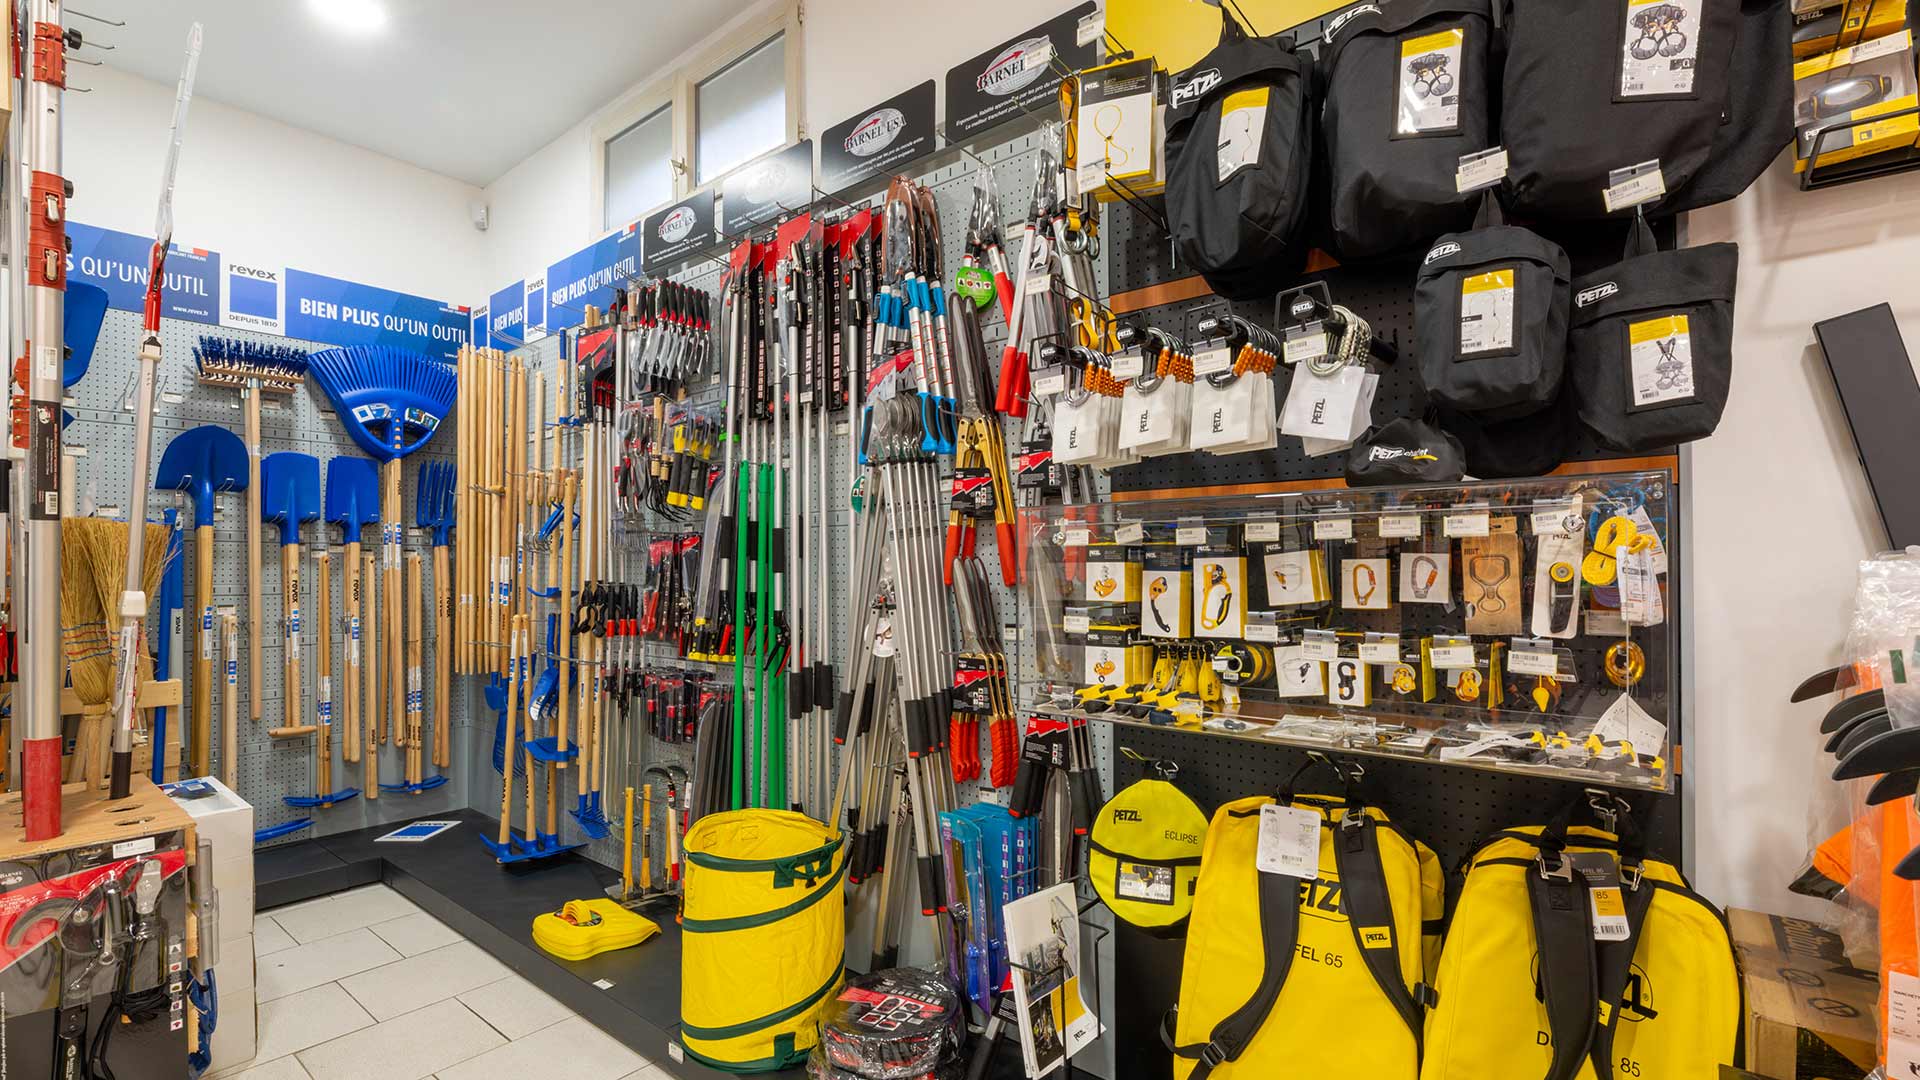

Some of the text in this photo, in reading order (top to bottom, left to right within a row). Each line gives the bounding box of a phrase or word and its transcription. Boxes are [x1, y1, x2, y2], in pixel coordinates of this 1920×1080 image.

[1324, 4, 1382, 44] PETZL
[1797, 10, 1824, 24] PETZL
[1172, 71, 1223, 109] PETZL
[844, 115, 907, 152] BARNEL USA
[1424, 243, 1461, 265] PETZL
[81, 256, 148, 283] QU'UN
[229, 263, 277, 280] revex
[528, 279, 545, 292] revex
[569, 277, 587, 301] PLUS
[1577, 283, 1619, 308] PETZL
[172, 305, 209, 316] www.revex.fr
[300, 298, 338, 321] BIEN
[342, 306, 380, 328] PLUS
[384, 315, 428, 337] QU'UN
[508, 306, 523, 327] PLUS
[1292, 301, 1314, 315] PETZL
[229, 314, 278, 328] DEPUIS 1810
[1199, 318, 1217, 332] PETZL
[1116, 329, 1134, 340] PETZL
[1140, 409, 1148, 433] PETZL
[1213, 407, 1223, 433] PETZL
[1311, 398, 1325, 425] PETZL
[1069, 426, 1077, 449] PETZL
[1114, 809, 1142, 825] PETZL
[1164, 830, 1198, 845] ECLIPSE
[1596, 891, 1608, 900] 85
[1366, 933, 1388, 944] PETZL
[1324, 952, 1343, 968] 65
[1620, 1057, 1640, 1078] 85
